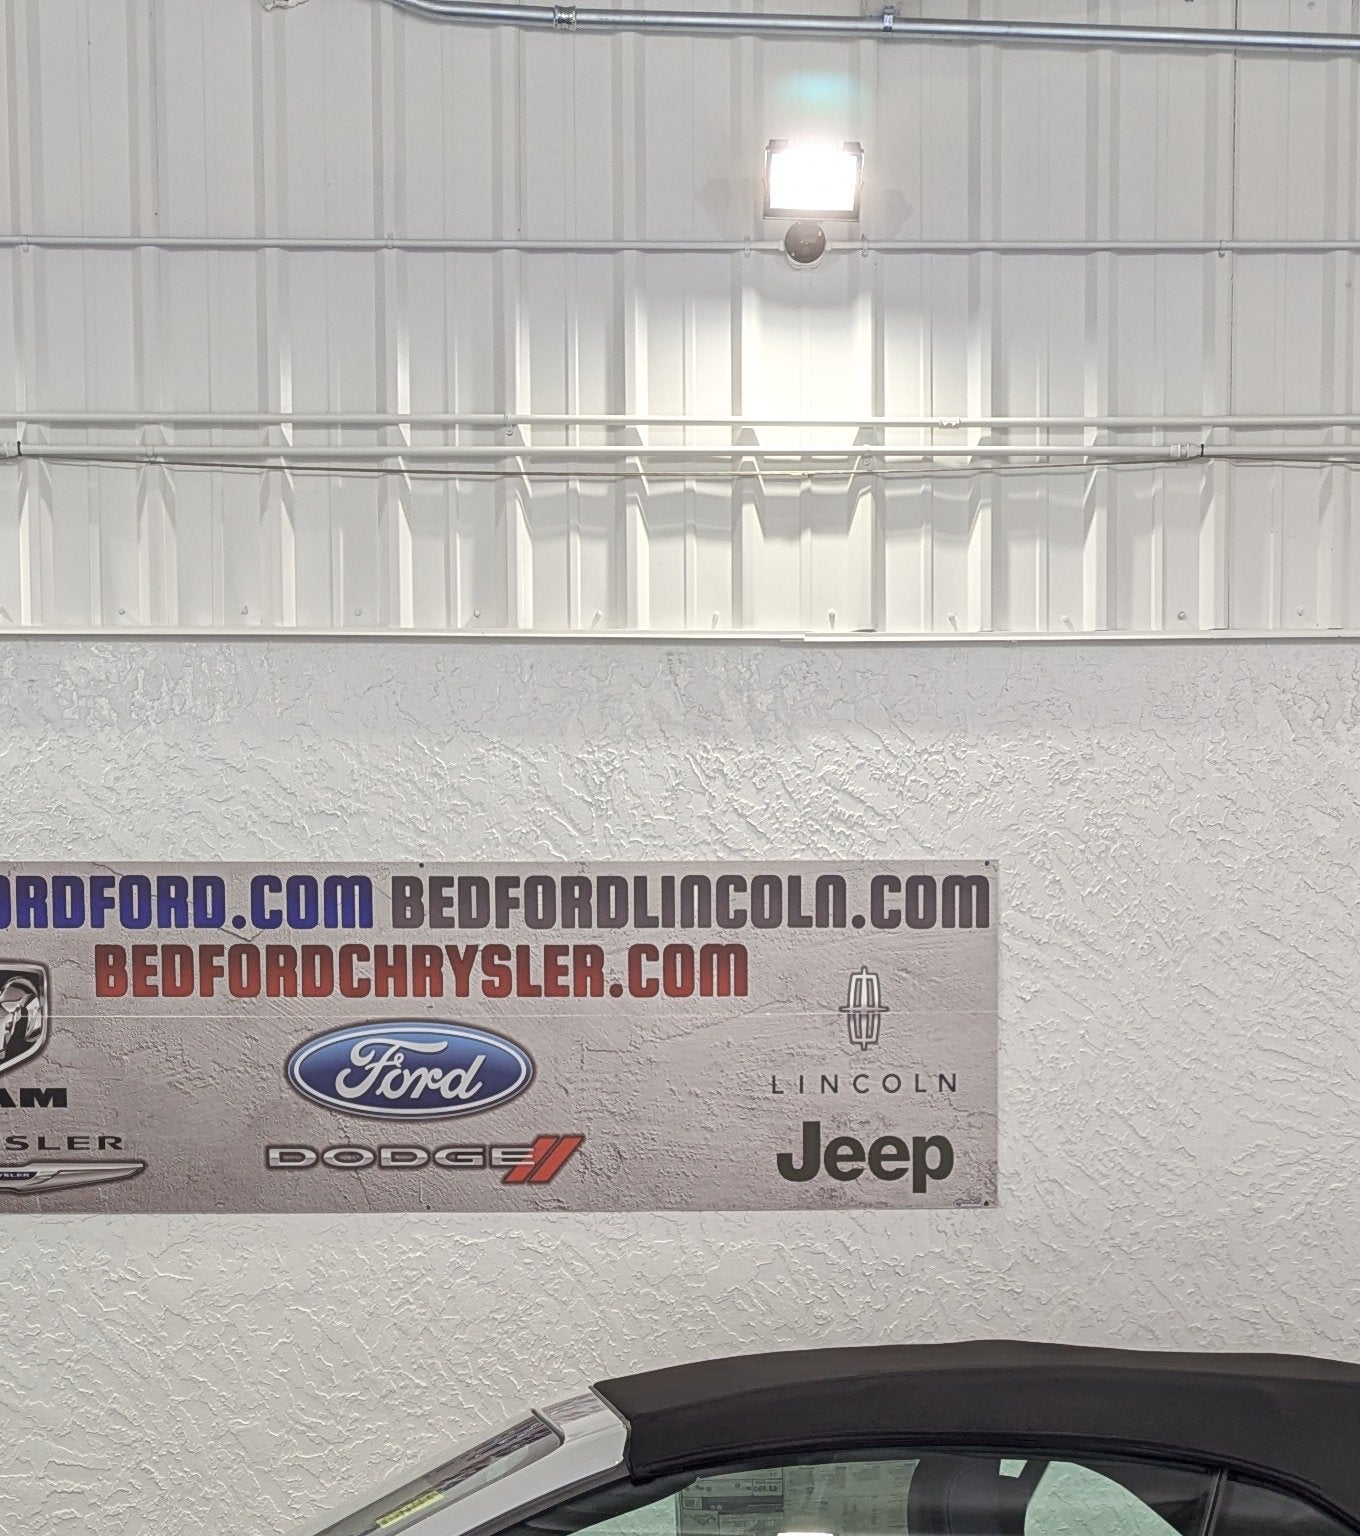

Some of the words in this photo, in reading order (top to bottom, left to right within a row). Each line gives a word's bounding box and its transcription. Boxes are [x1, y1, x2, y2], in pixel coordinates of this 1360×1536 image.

[391, 874, 990, 929] BEDFORDLINCOLN.COM
[95, 943, 748, 998] BEDFORDCHRYSLER.COM
[335, 1038, 487, 1100] Ford
[772, 1073, 957, 1094] LINCOLN
[266, 1145, 536, 1169] DODGE
[776, 1120, 955, 1194] Jeep
